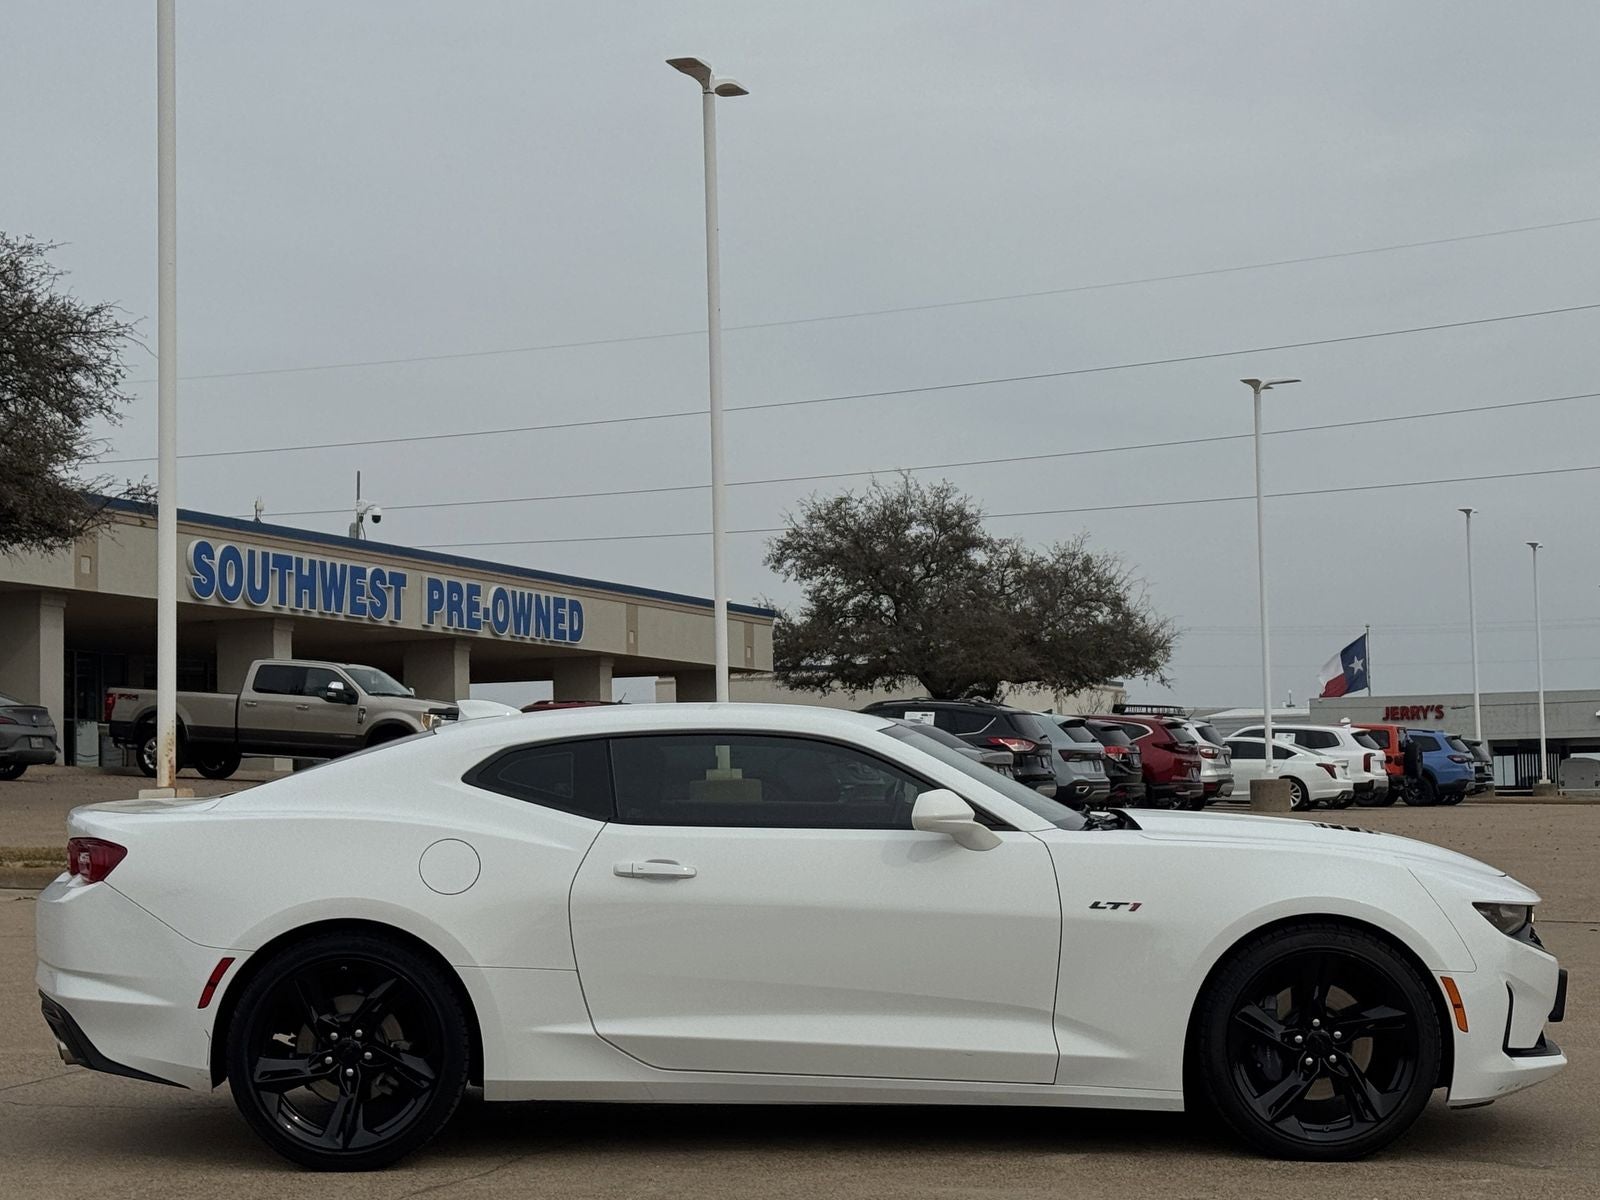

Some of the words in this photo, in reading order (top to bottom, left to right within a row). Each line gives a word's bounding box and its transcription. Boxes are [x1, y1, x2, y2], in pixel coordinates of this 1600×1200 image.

[187, 540, 407, 621] SOUTHWEST
[425, 575, 585, 644] PRE-OWNED
[1382, 704, 1445, 721] JERRY'S
[1088, 901, 1143, 912] LT1
